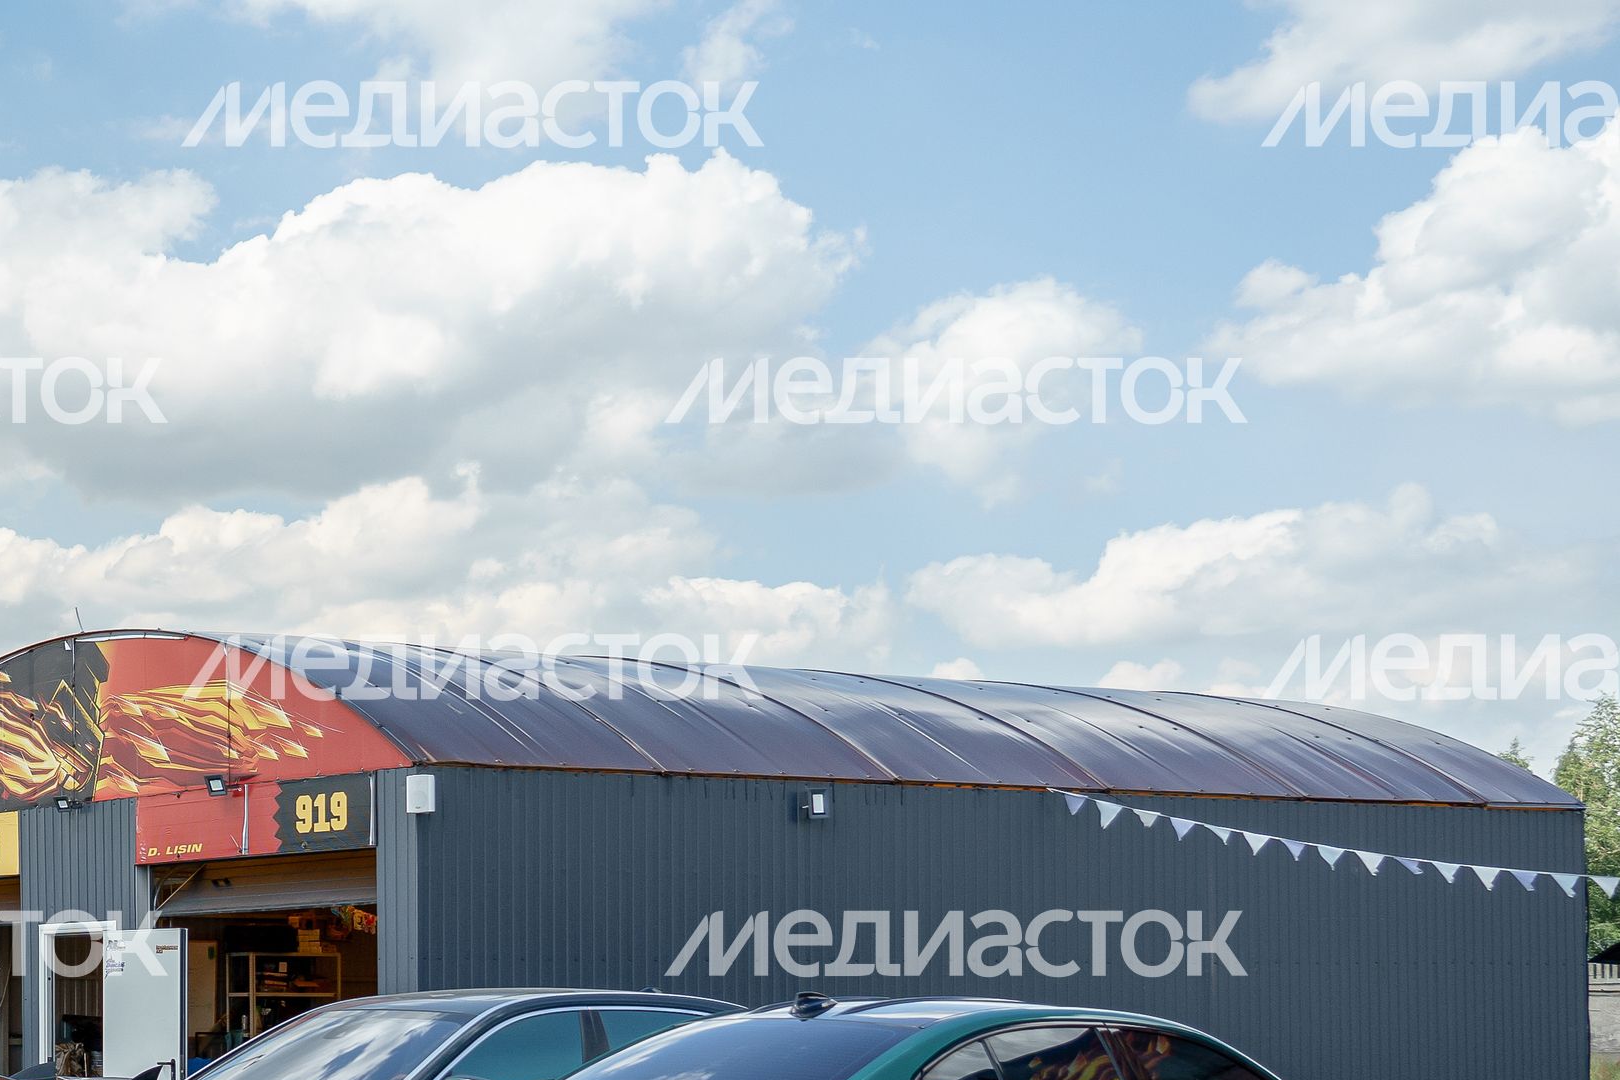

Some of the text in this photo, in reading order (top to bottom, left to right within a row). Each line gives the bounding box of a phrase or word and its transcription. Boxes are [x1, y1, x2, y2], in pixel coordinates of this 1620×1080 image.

[295, 791, 348, 834] 919
[147, 843, 203, 857] D. LISIN
